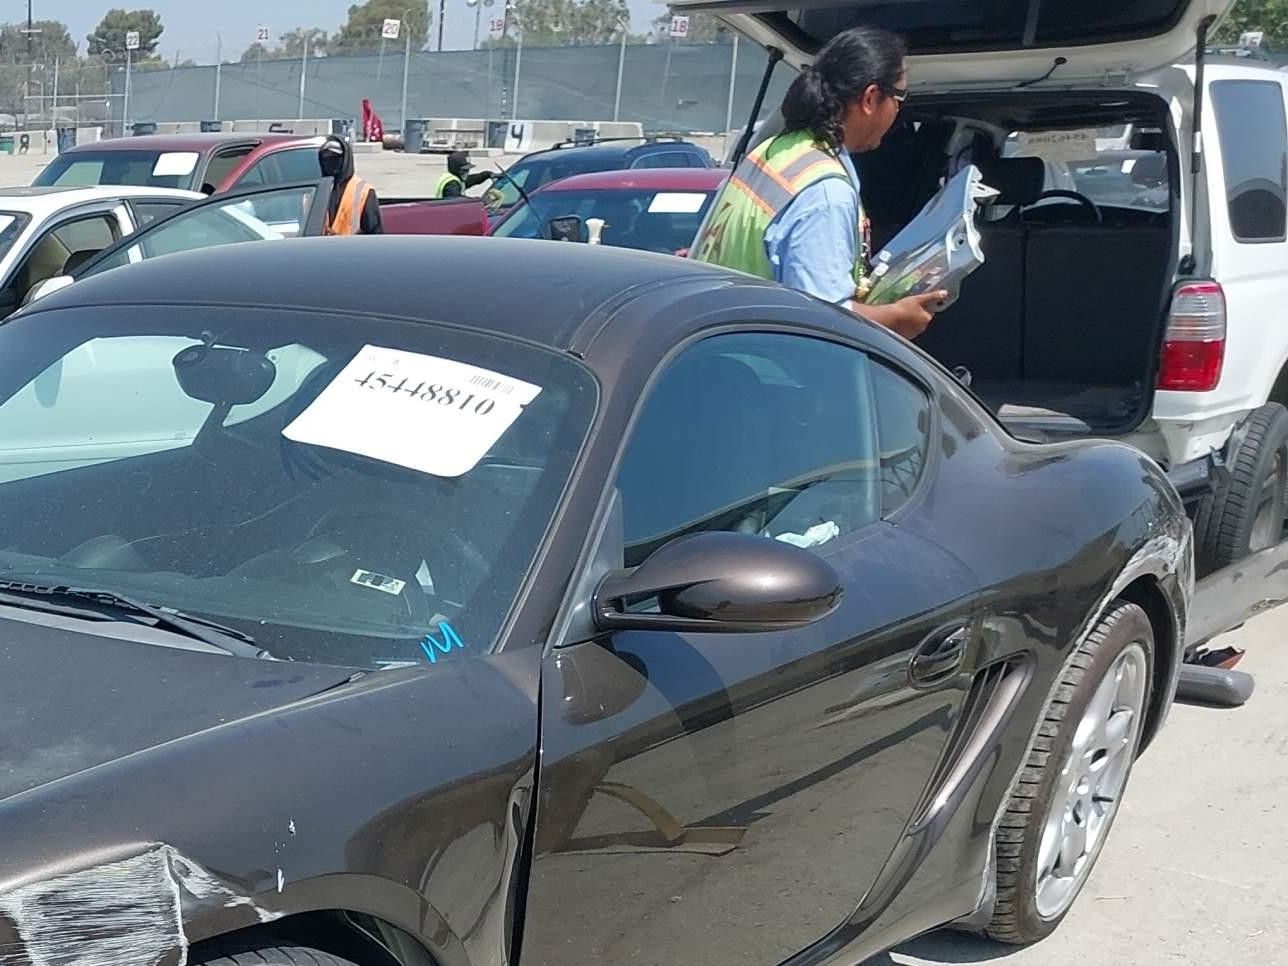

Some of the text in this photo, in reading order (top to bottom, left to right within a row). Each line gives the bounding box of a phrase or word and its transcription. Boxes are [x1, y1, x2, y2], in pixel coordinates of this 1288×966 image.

[384, 22, 398, 34] 20
[490, 20, 503, 31] 19
[672, 20, 687, 32] 18
[128, 35, 138, 46] 22
[258, 29, 268, 40] 21
[511, 125, 524, 148] 4
[354, 370, 496, 416] 45448810
